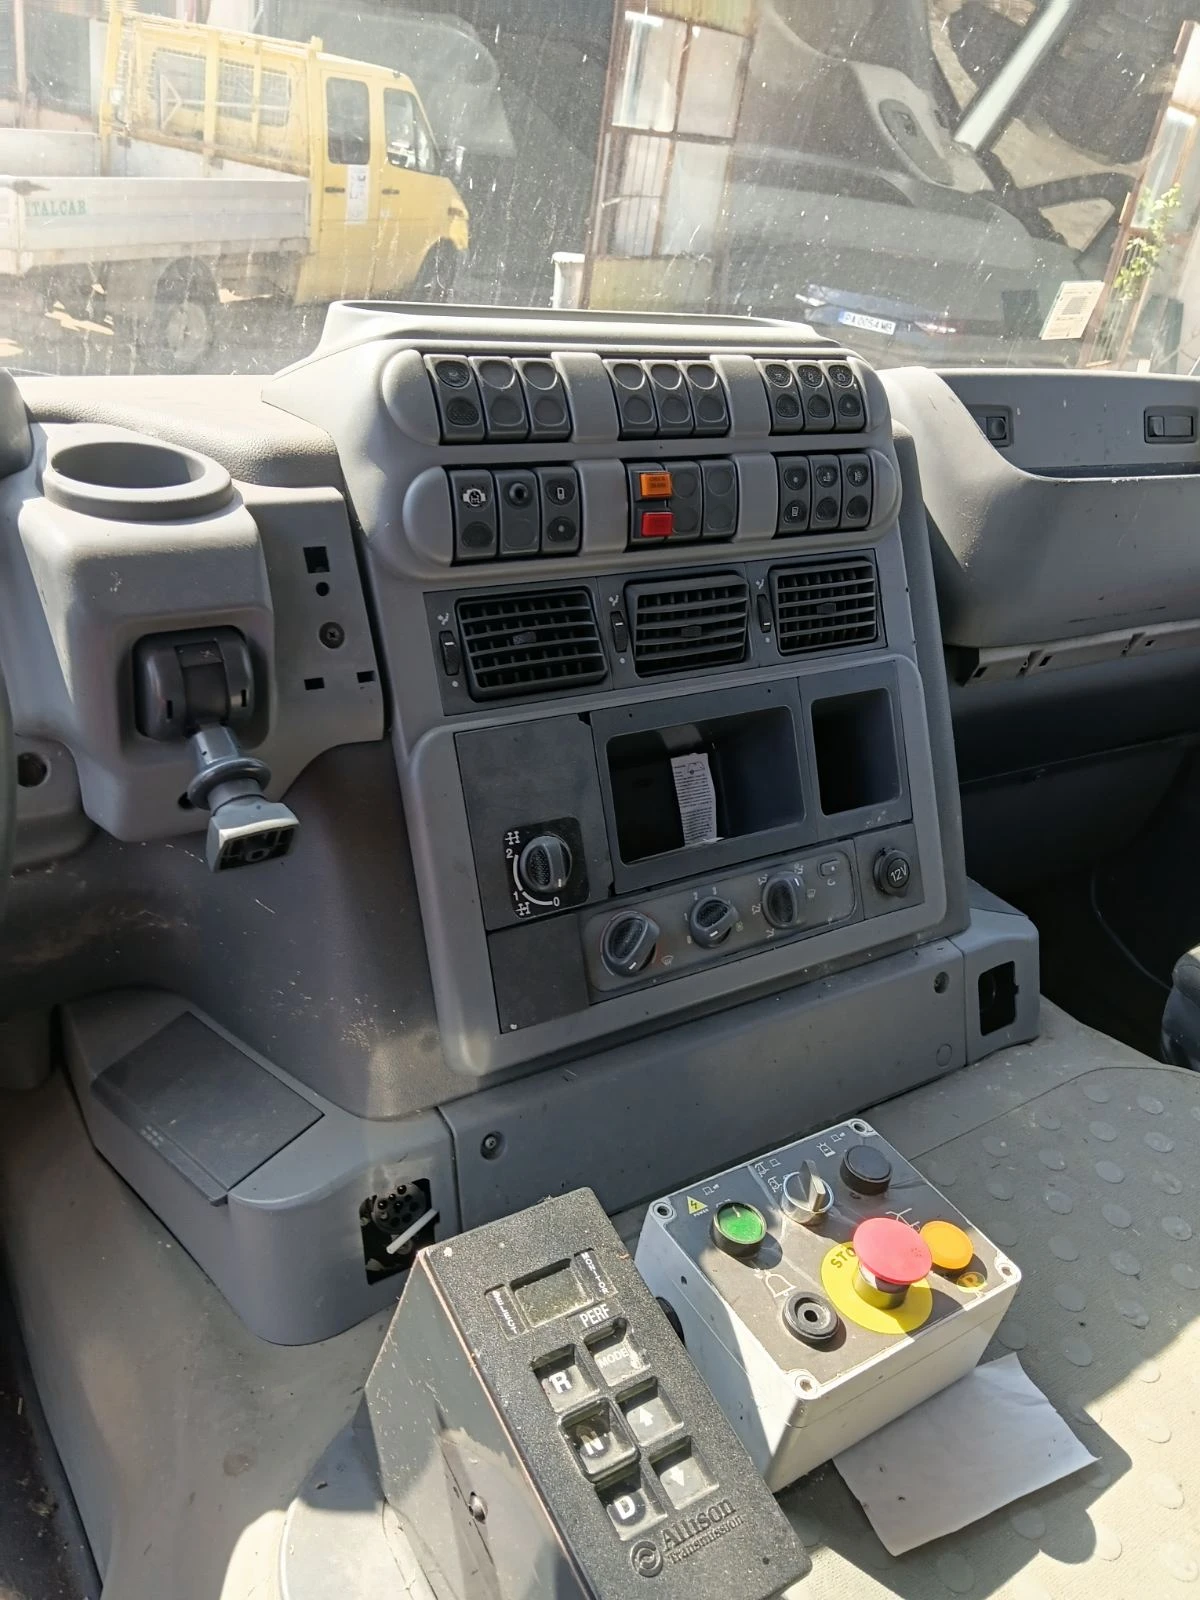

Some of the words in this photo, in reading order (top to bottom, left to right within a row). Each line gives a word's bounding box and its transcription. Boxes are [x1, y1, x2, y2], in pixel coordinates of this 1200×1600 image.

[505, 848, 513, 859] 2
[890, 861, 907, 882] 12V
[513, 891, 519, 901] 1
[553, 896, 560, 907] 0
[830, 1246, 857, 1269] STO
[580, 1251, 609, 1295] MONITOR
[491, 1290, 518, 1334] SELECT
[579, 1303, 610, 1328] PERF
[598, 1347, 630, 1368] MODE
[549, 1371, 572, 1394] R
[579, 1431, 604, 1455] N
[613, 1495, 636, 1520] D
[660, 1499, 737, 1552] Allison
[667, 1514, 744, 1565] Transmission
